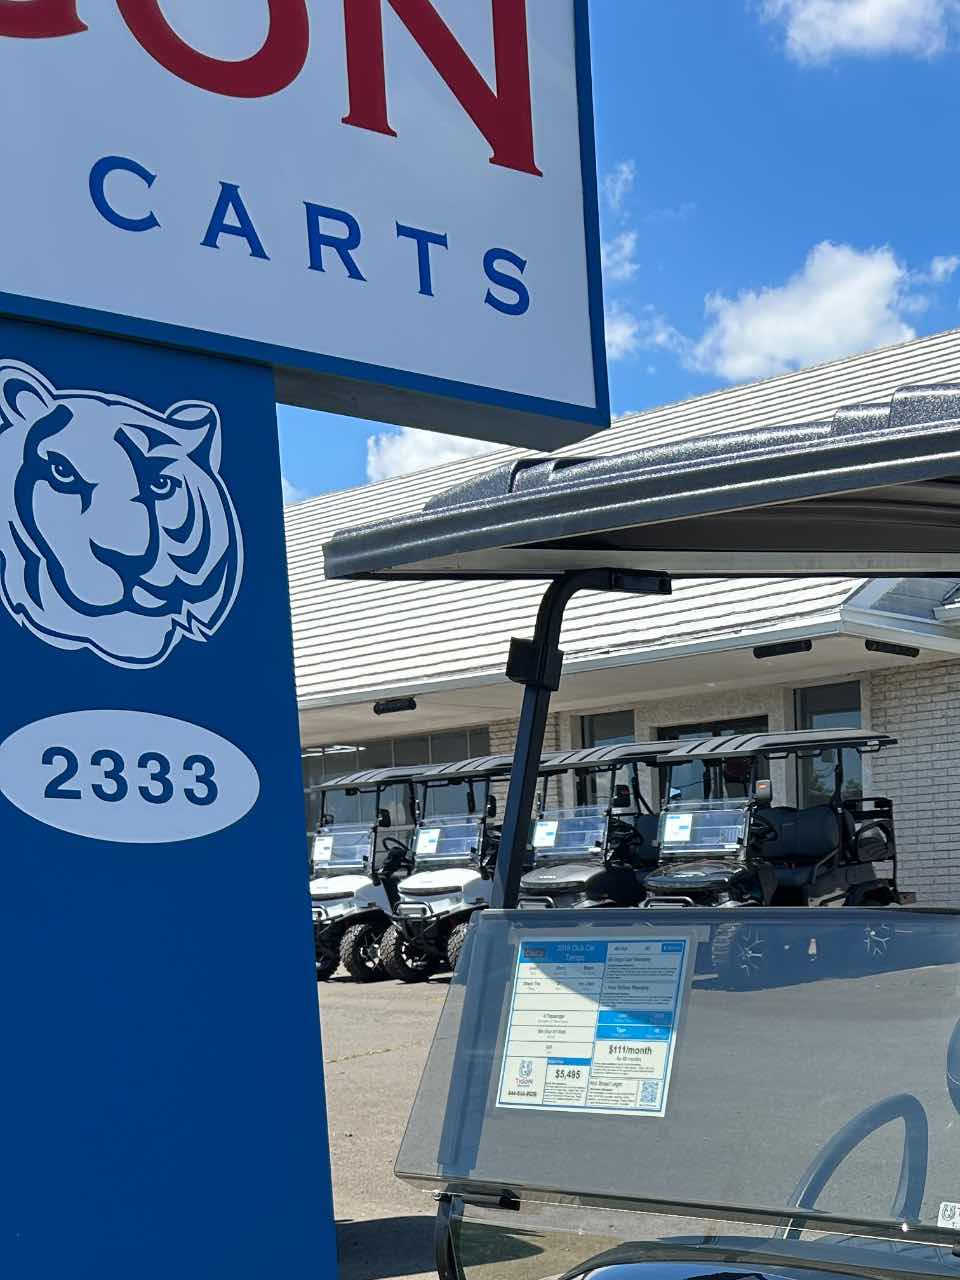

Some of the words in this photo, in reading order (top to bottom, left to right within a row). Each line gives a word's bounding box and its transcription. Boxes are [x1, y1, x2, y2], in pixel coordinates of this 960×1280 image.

[88, 155, 530, 316] CARTS
[41, 746, 219, 806] 2333
[608, 1045, 652, 1055] $111/month
